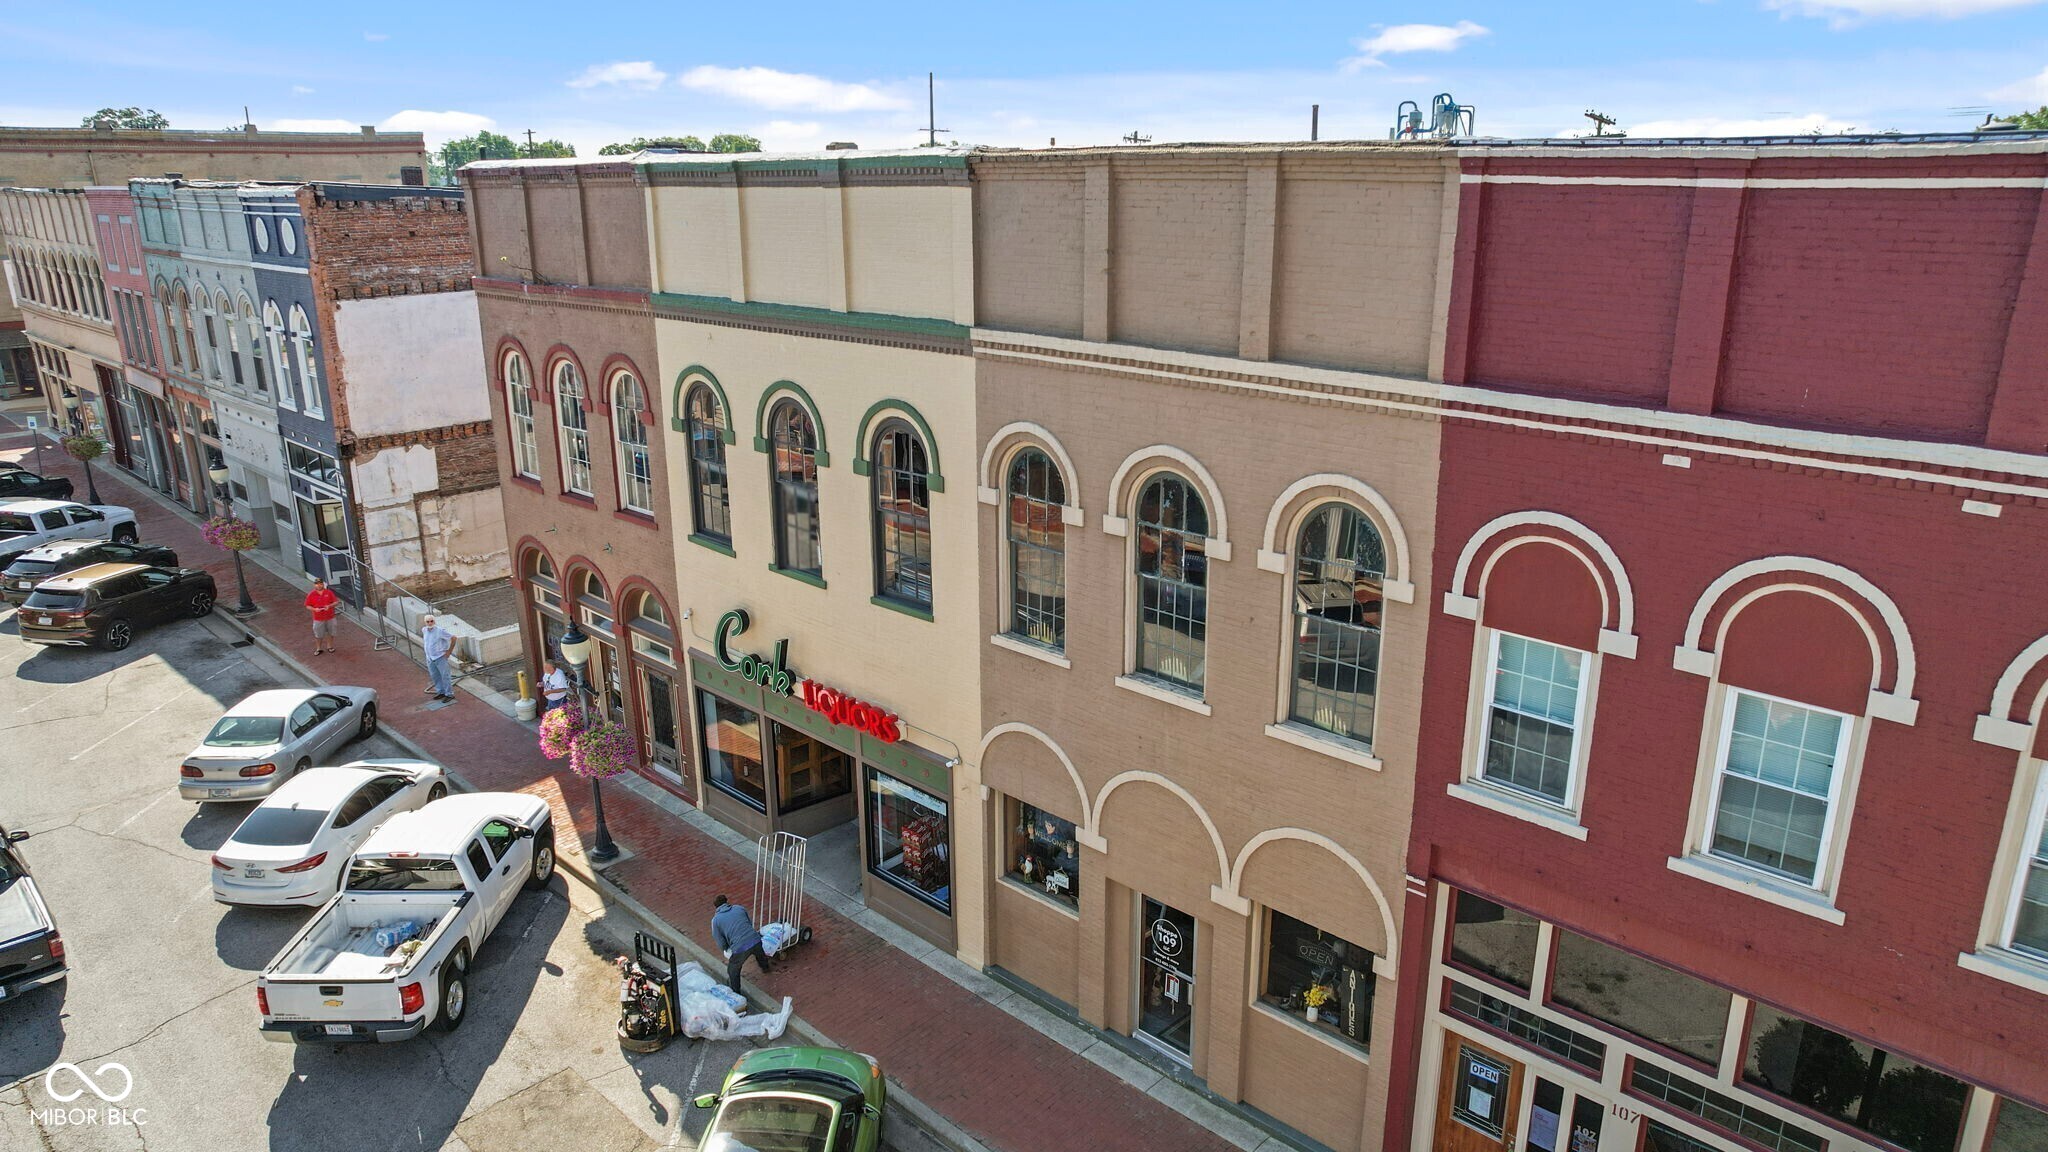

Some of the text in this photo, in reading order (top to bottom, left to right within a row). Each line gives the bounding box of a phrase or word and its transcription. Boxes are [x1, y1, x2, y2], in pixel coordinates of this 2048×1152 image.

[713, 608, 796, 698] Cork
[802, 678, 901, 743] LIQUORS
[1158, 932, 1177, 948] 109
[1300, 946, 1334, 965] OPEN
[1472, 1064, 1498, 1082] OPEN
[1612, 1103, 1640, 1124] 107
